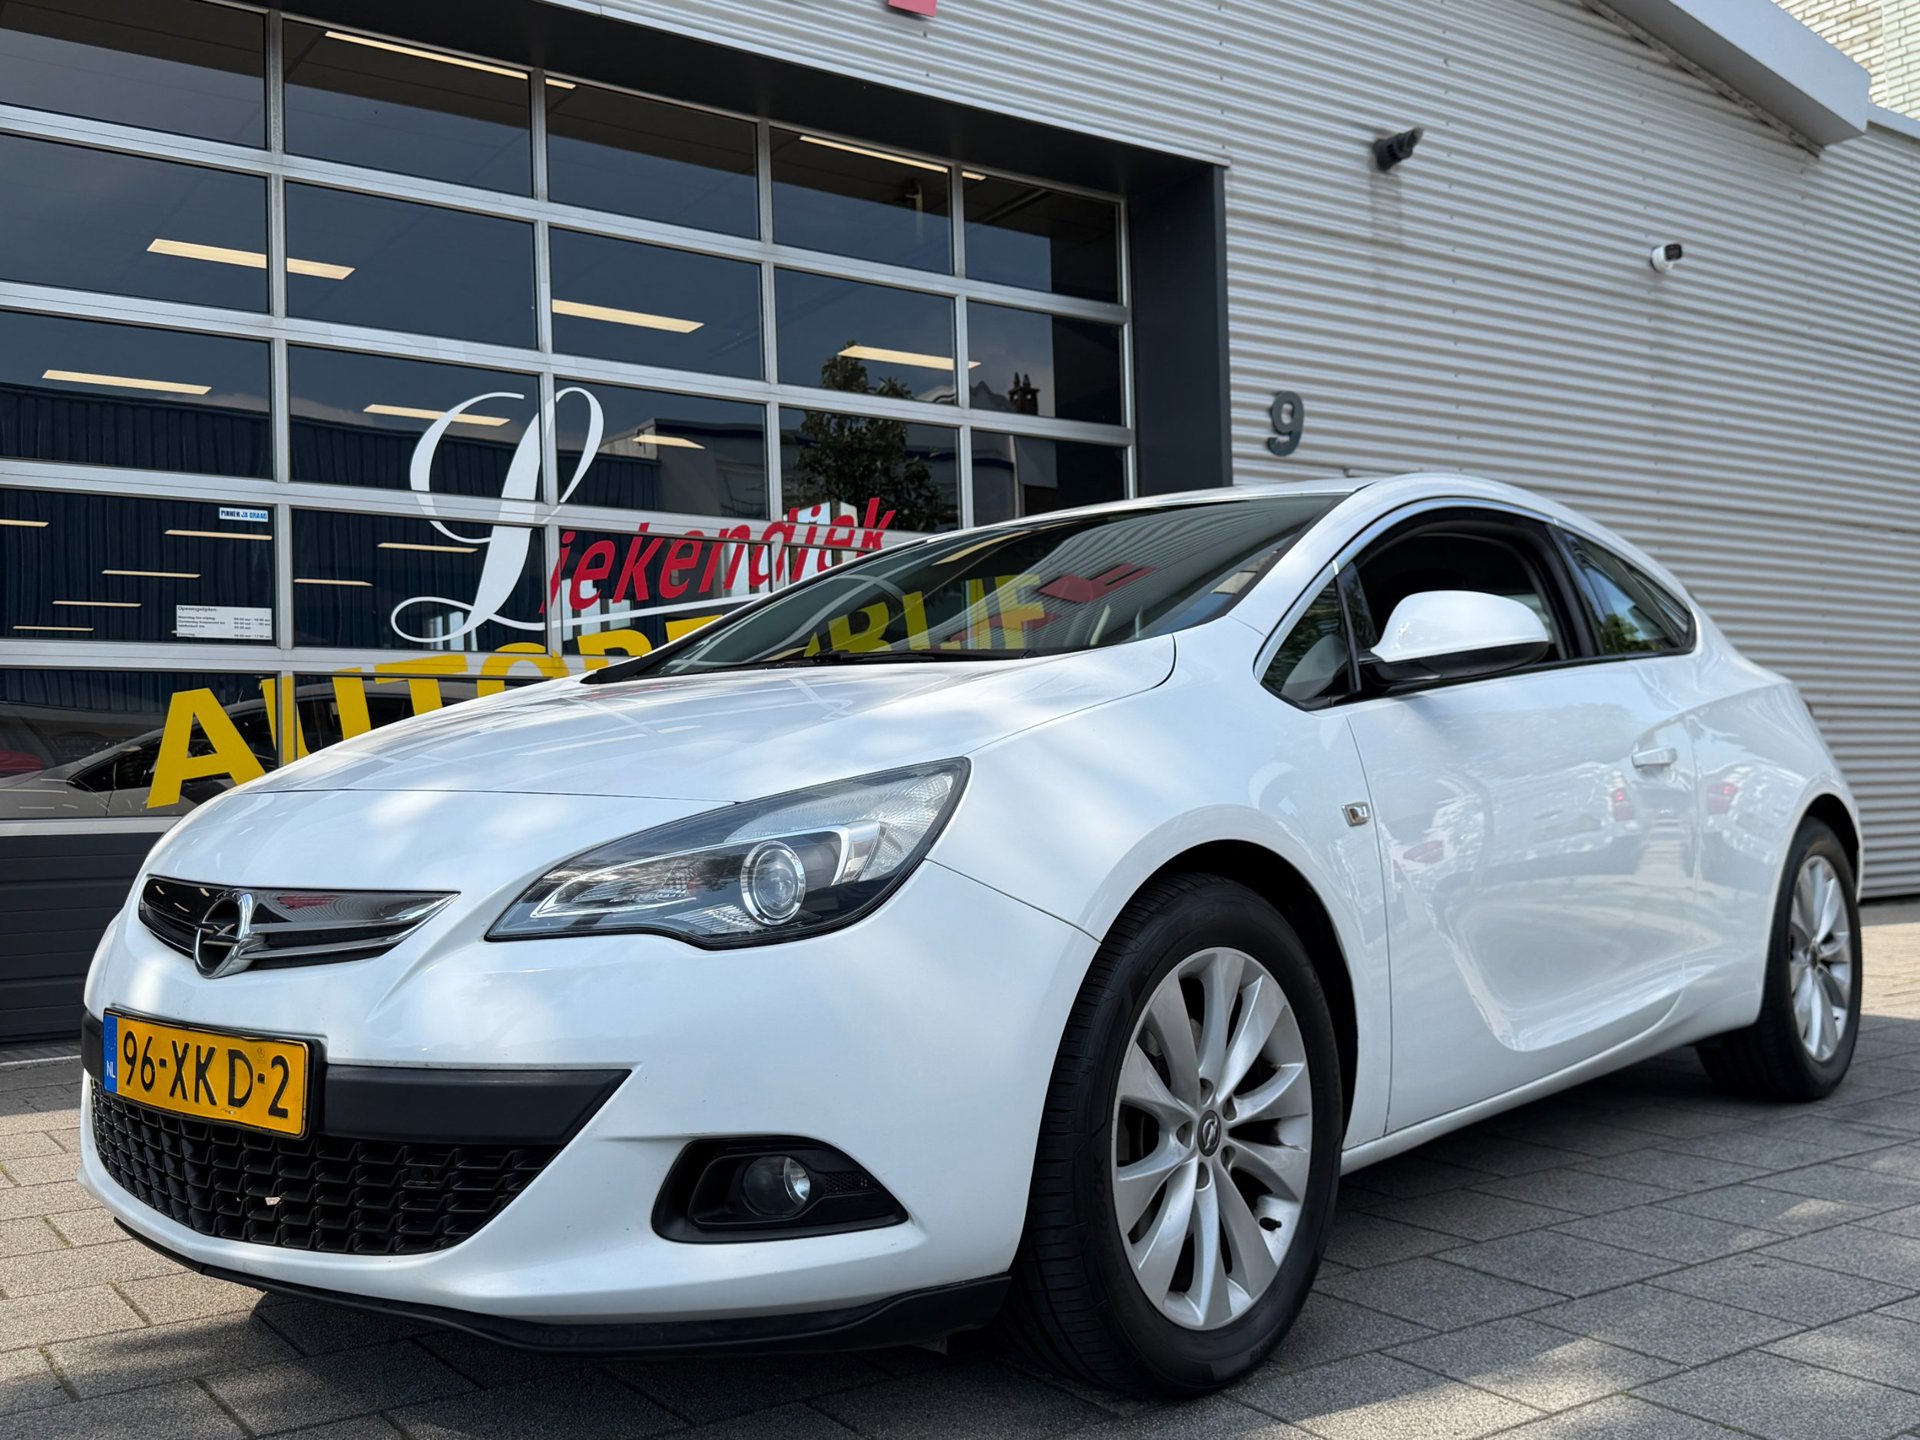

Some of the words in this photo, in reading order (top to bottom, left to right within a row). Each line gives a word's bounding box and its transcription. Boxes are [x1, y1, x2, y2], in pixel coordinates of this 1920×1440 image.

[1266, 390, 1306, 457] 9
[105, 1059, 117, 1080] NL
[122, 1029, 290, 1120] 96-XKD-2
